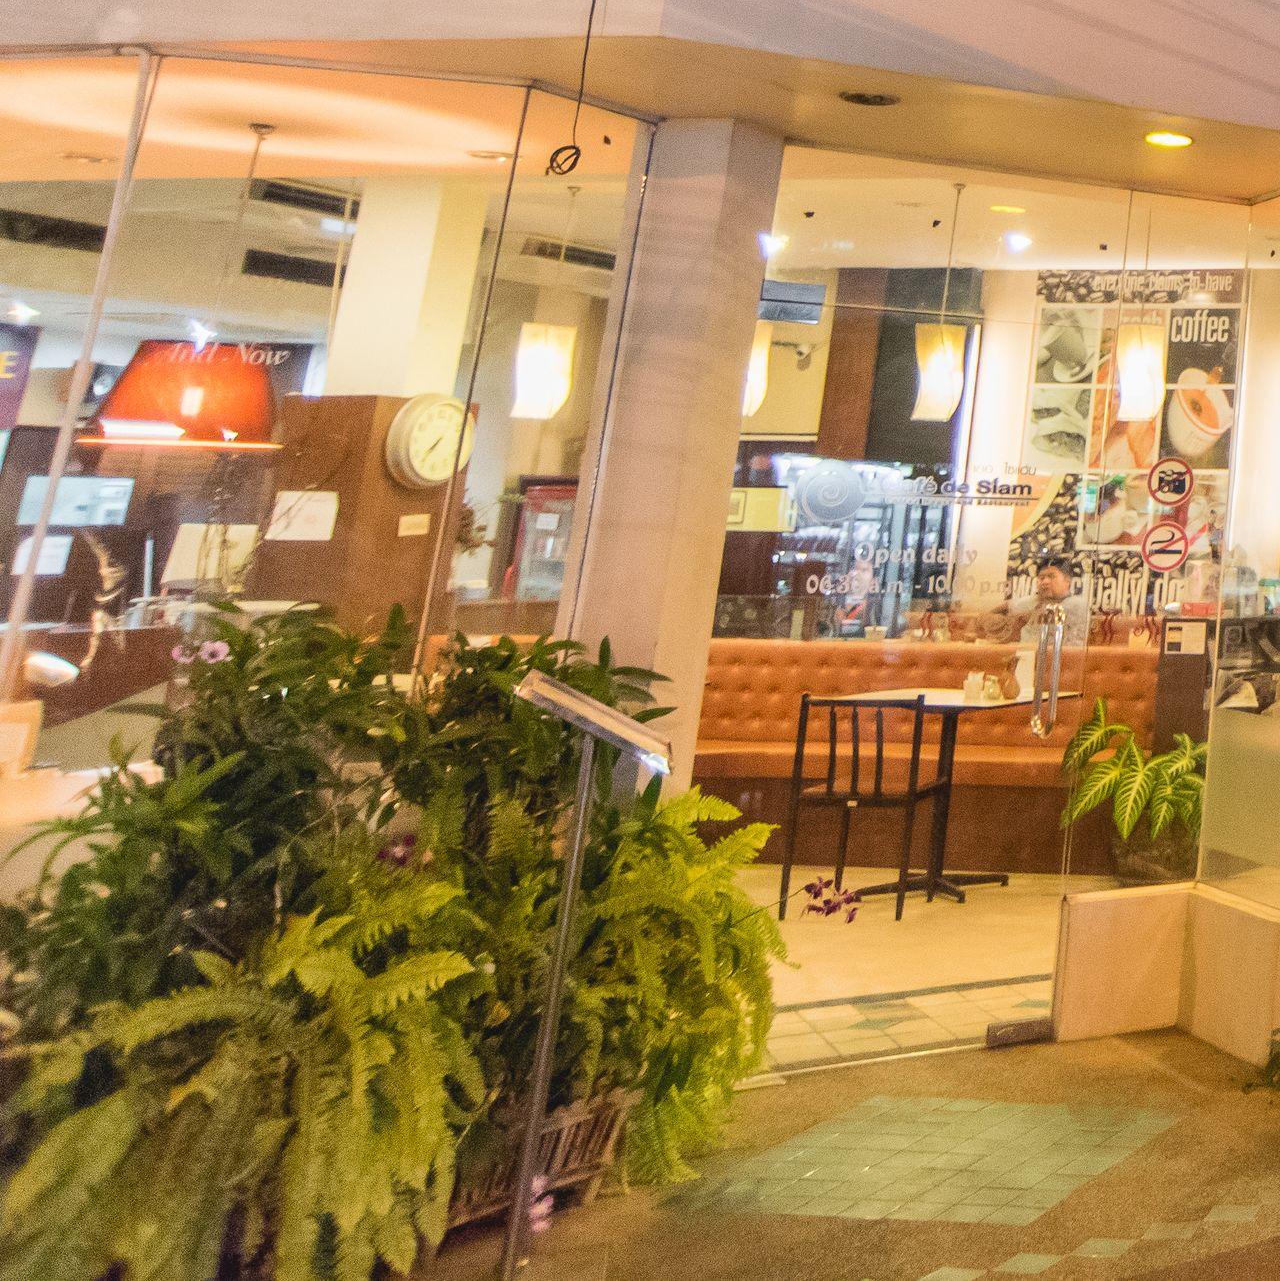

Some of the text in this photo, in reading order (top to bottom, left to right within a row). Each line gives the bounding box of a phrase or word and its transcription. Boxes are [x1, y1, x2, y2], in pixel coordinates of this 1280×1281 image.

[1205, 272, 1233, 292] have
[1170, 308, 1230, 343] coffee
[942, 477, 971, 495] de
[976, 476, 1033, 496] Siam
[856, 541, 978, 567] Open daly
